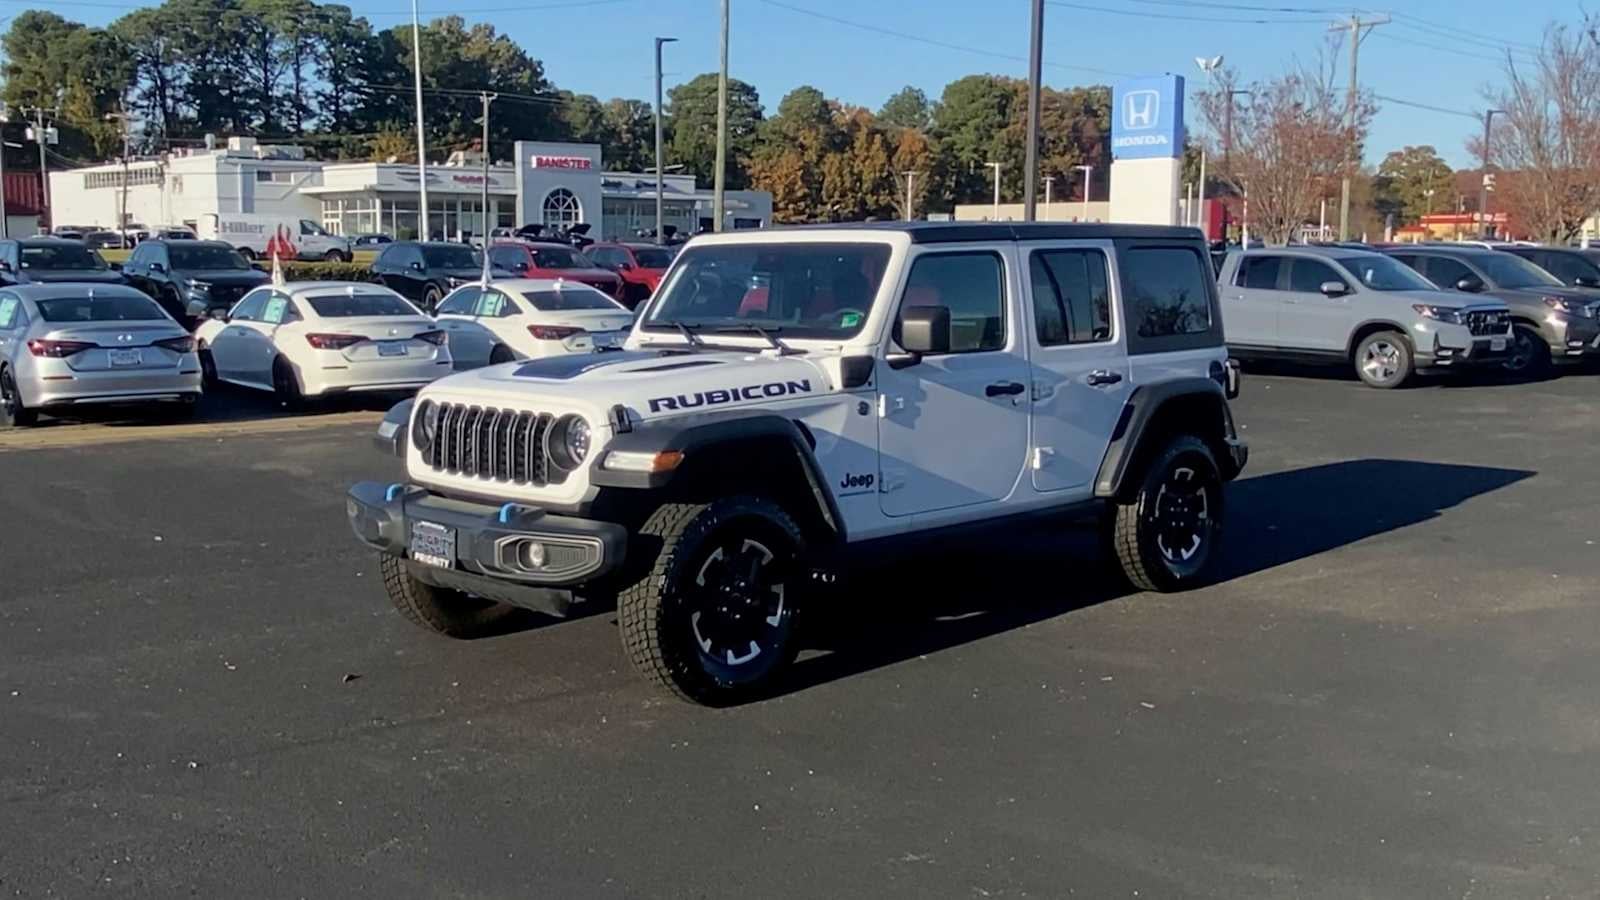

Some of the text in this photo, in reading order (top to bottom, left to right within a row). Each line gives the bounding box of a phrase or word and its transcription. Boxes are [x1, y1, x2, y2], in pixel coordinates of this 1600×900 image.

[1113, 135, 1169, 147] HONDA
[535, 156, 592, 170] BANISTER
[221, 221, 265, 233] Hiller
[649, 379, 812, 413] RUBICON
[840, 472, 875, 489] Jeep
